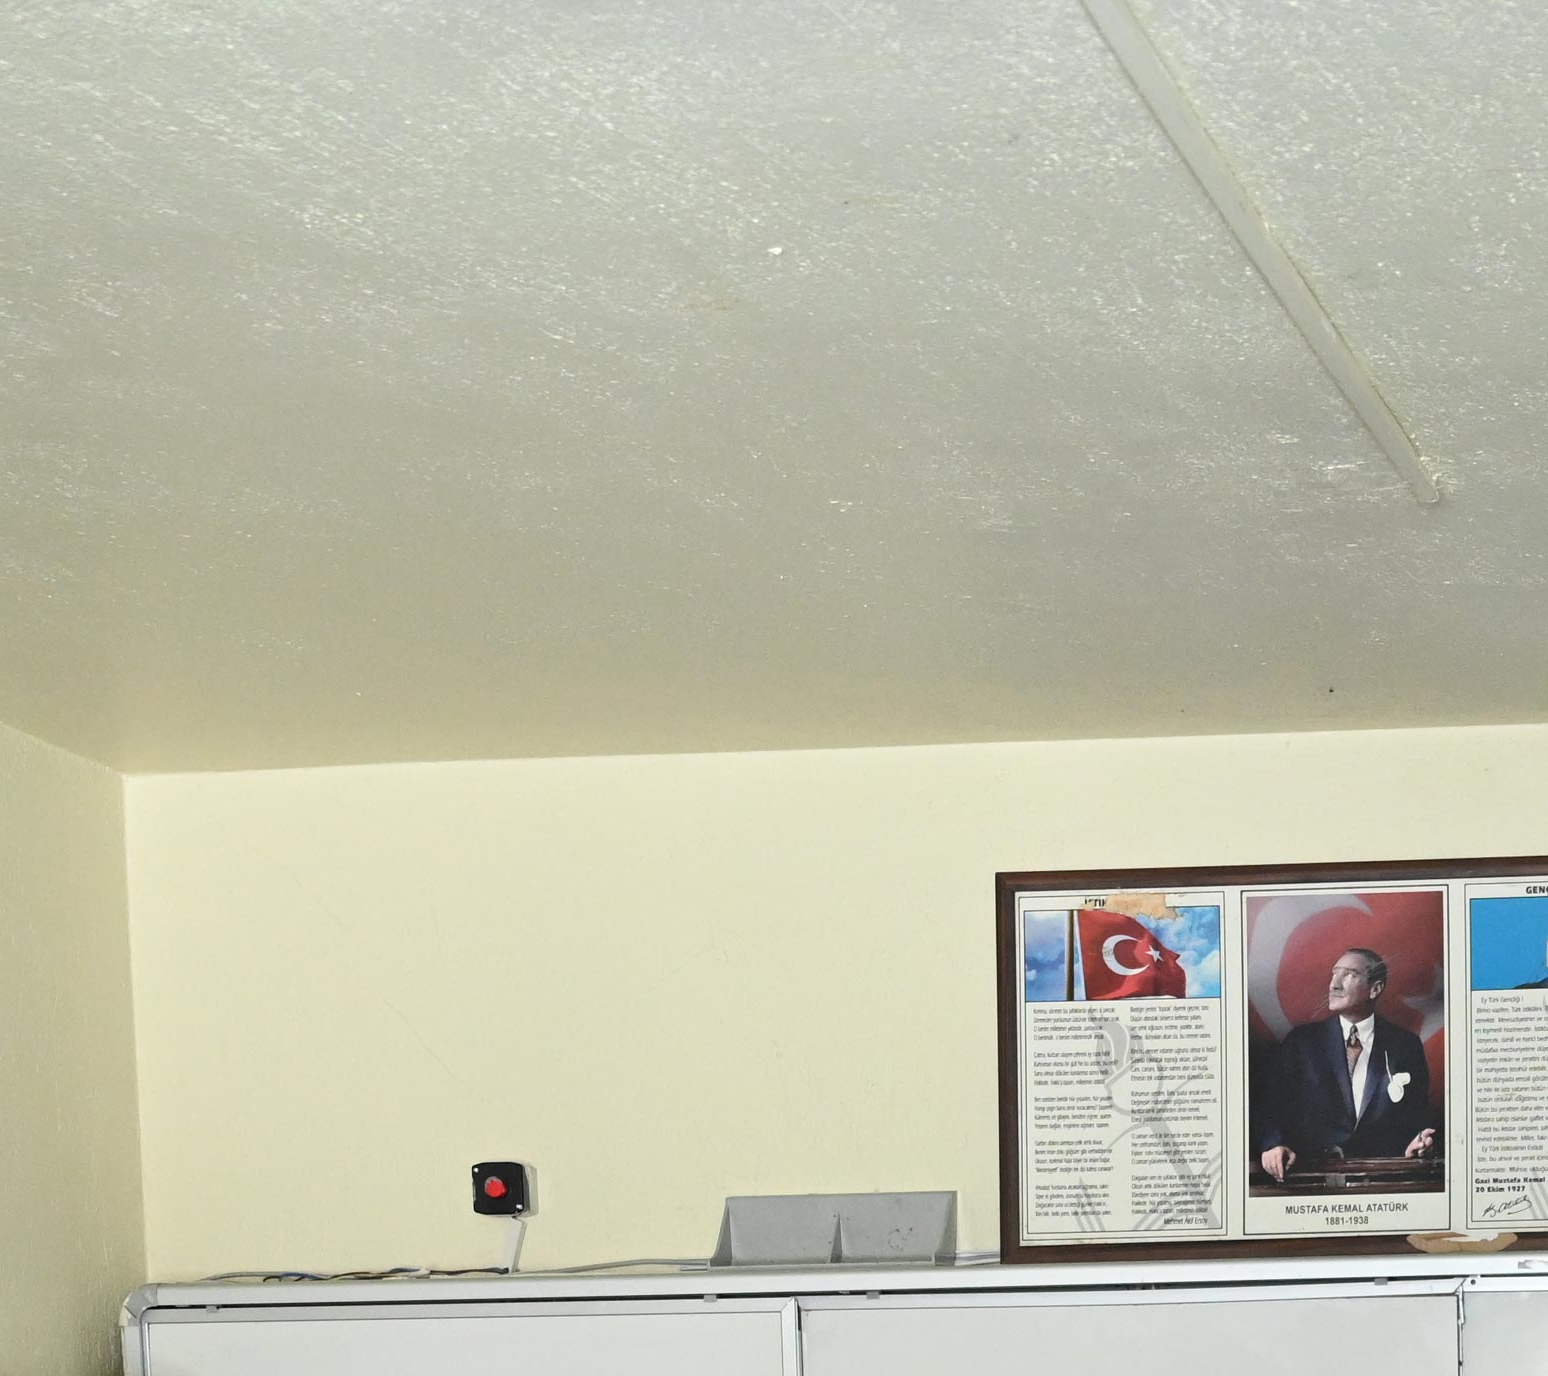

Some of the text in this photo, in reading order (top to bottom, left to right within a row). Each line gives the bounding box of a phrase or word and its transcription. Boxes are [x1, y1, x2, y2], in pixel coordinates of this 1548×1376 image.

[1493, 1176, 1521, 1184] Mustafa
[1286, 1202, 1409, 1214] MUSTAFA KEMAL ATATÜRK
[1325, 1216, 1369, 1225] 1881-1938
